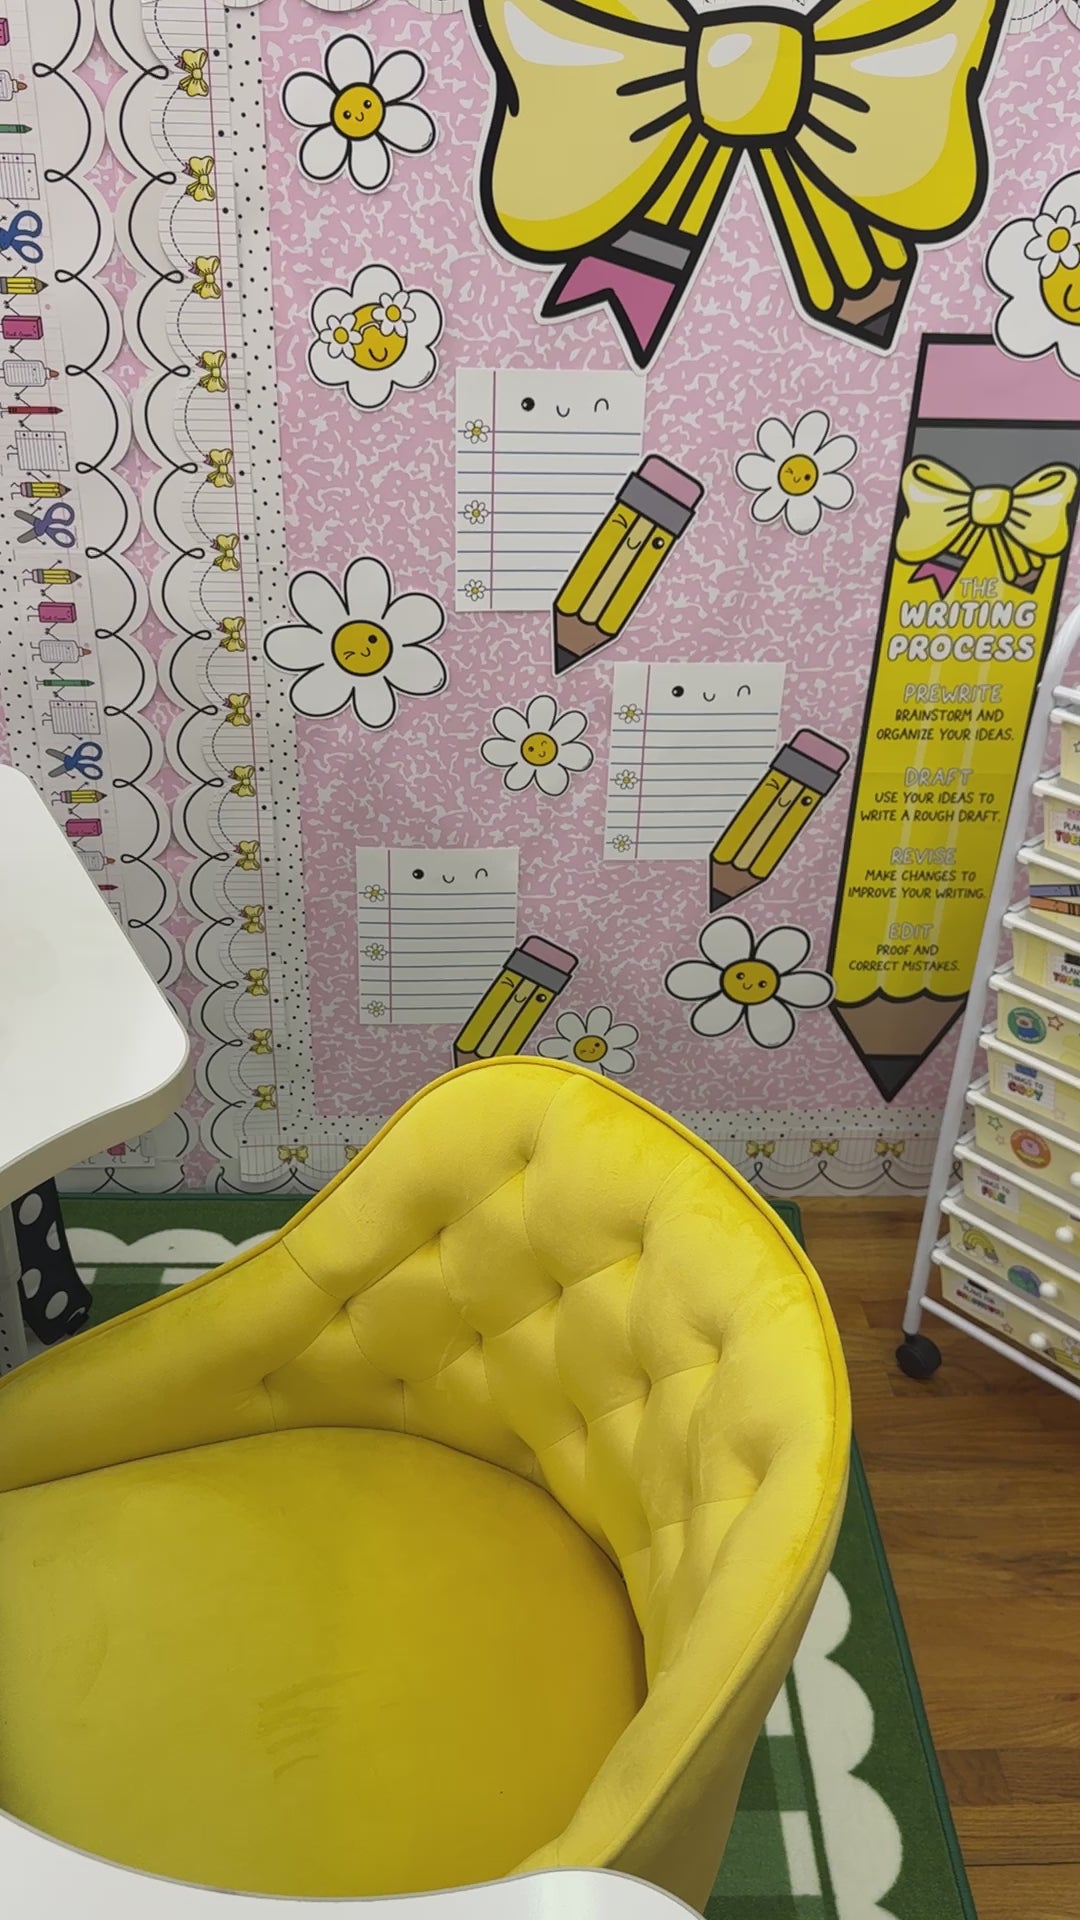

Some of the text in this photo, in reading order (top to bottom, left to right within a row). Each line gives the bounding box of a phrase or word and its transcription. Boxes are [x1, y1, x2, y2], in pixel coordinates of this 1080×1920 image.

[960, 577, 998, 598] THE
[900, 601, 1037, 628] WRITING
[887, 634, 1036, 661] PROCESS
[904, 683, 1003, 703] PREWRITE
[895, 709, 1004, 721] BRAINSTORM AND
[876, 728, 1014, 741] ORGANIZE YOUR IDEAS.
[904, 767, 974, 787] DRAFT
[875, 791, 994, 804] USE YOUR IDEAS TO
[860, 810, 1000, 823] WRITE A ROUGH DRAFT.
[890, 847, 957, 865] REVISE
[864, 870, 976, 882] MAKE CHANGES TO
[848, 887, 986, 899] IMPROVE YOUR WRITING.
[888, 922, 934, 940] EDIT
[876, 944, 939, 956] PROOF AND
[848, 960, 960, 972] CORRECT MISTAKES.
